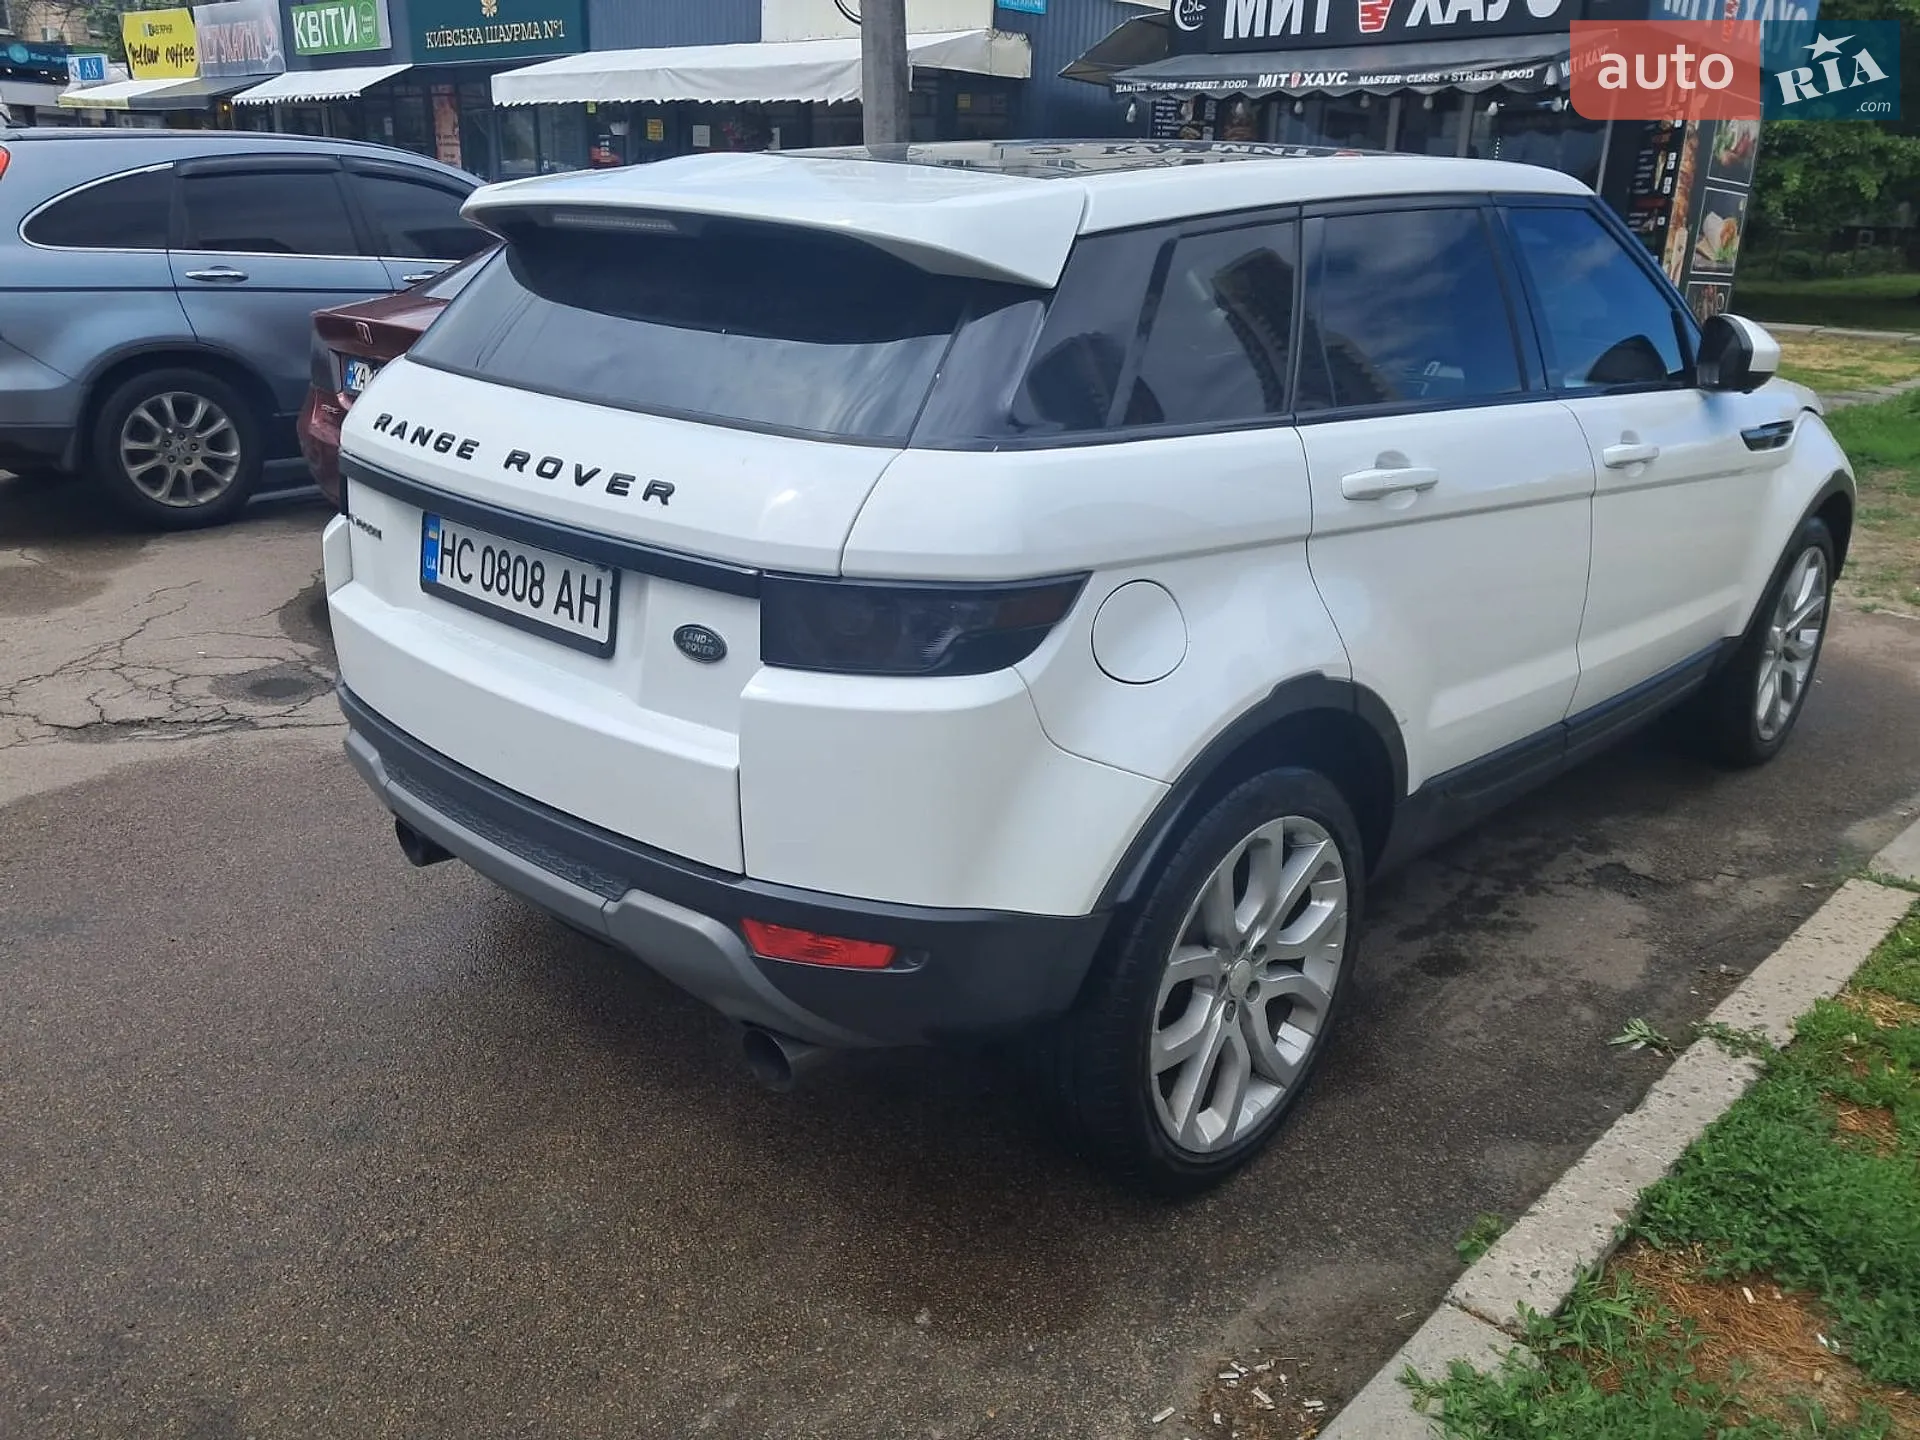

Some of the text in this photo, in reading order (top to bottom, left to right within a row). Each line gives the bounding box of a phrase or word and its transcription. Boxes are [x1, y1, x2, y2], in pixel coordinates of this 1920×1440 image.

[292, 6, 358, 49] КВІТИ
[425, 25, 484, 49] КИЇВСЬКА
[485, 21, 542, 44] ШАУРМА
[165, 43, 195, 69] coffee
[1115, 79, 1248, 93] MASTER CLASS STREET FOOD
[1257, 71, 1349, 88] МІТ ХАУС
[1359, 69, 1535, 85] MASTER CLASS STREET FOOD
[373, 413, 676, 506] RANGE ROVER
[439, 529, 604, 630] HC 0808 AH
